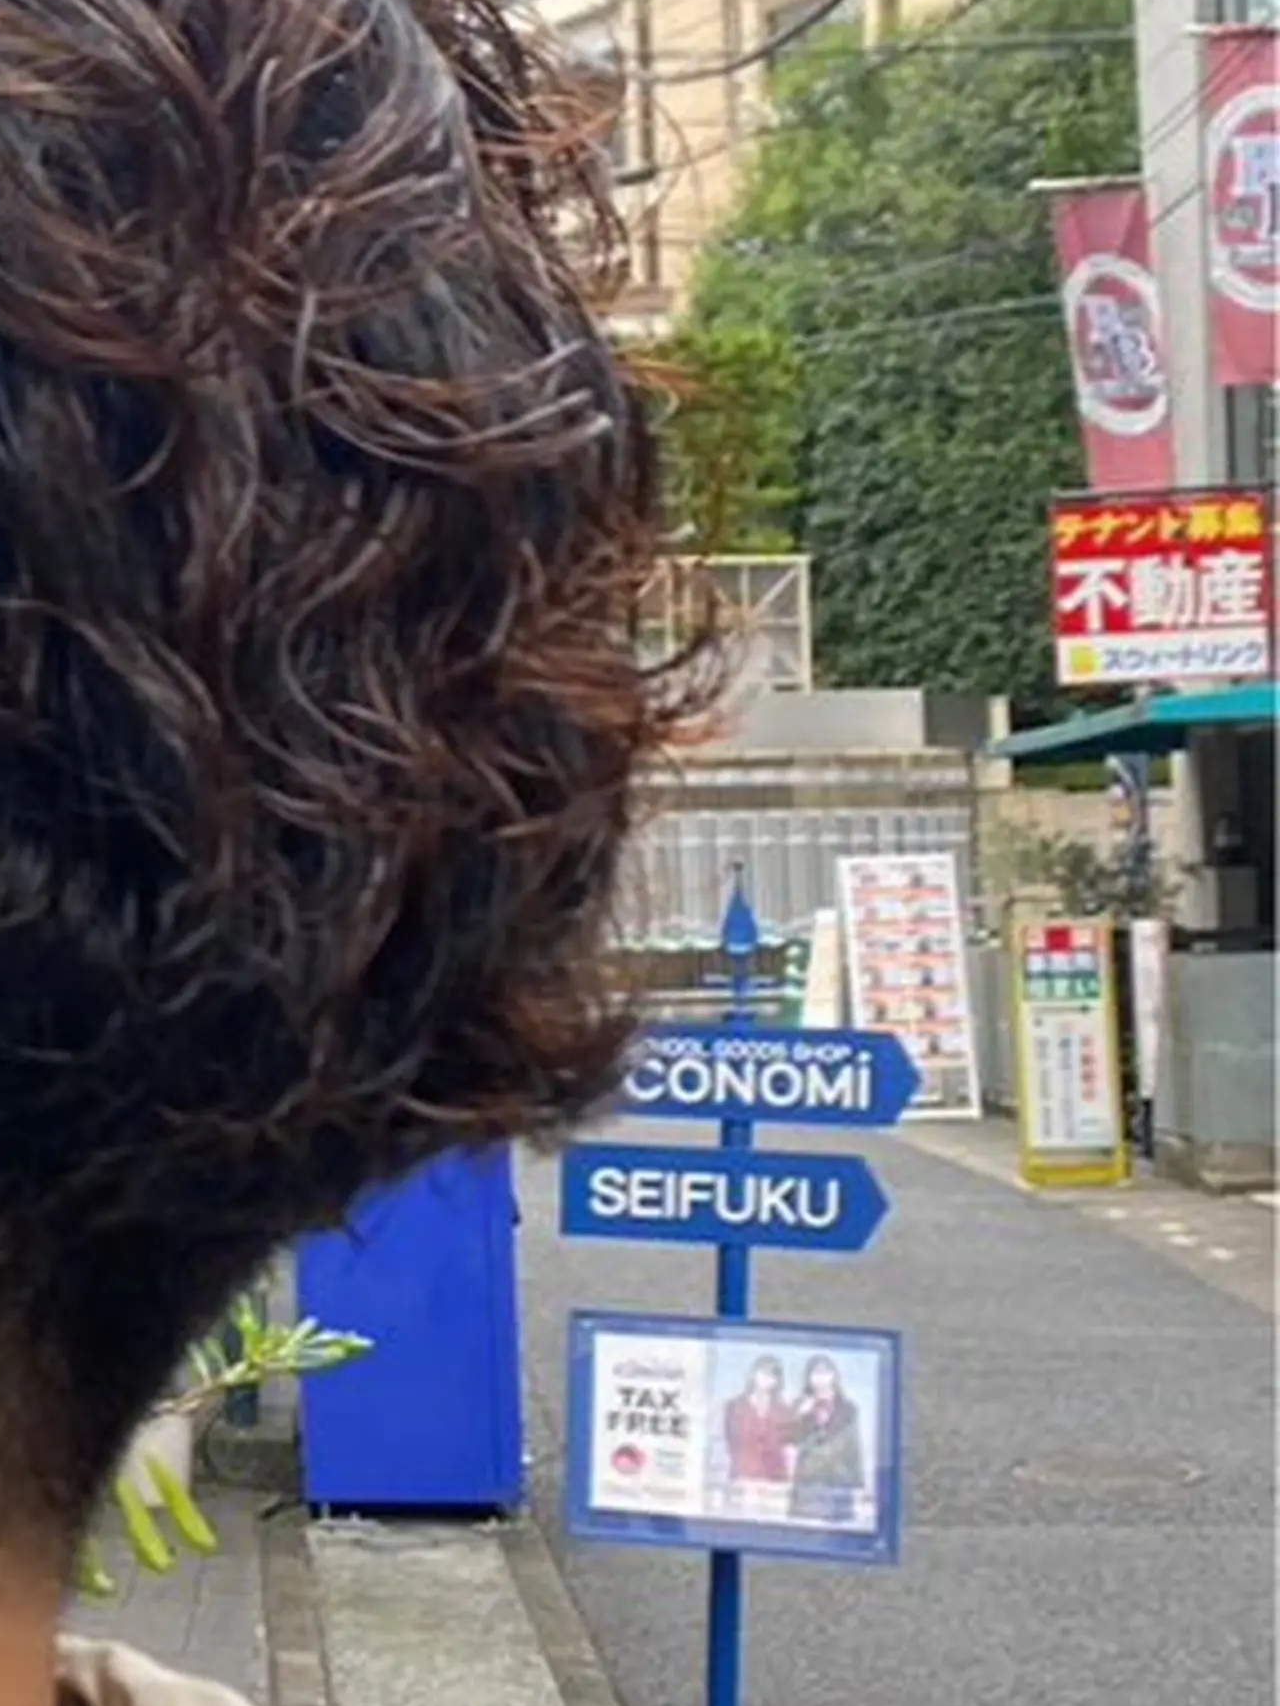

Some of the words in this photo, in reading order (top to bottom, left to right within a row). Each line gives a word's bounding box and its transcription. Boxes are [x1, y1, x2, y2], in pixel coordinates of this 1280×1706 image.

[1056, 550, 1268, 630] 不動産
[792, 1041, 853, 1064] SHOP
[589, 1166, 840, 1227] SEIFUKU
[615, 1386, 682, 1410] TAX
[606, 1409, 689, 1438] FREE
